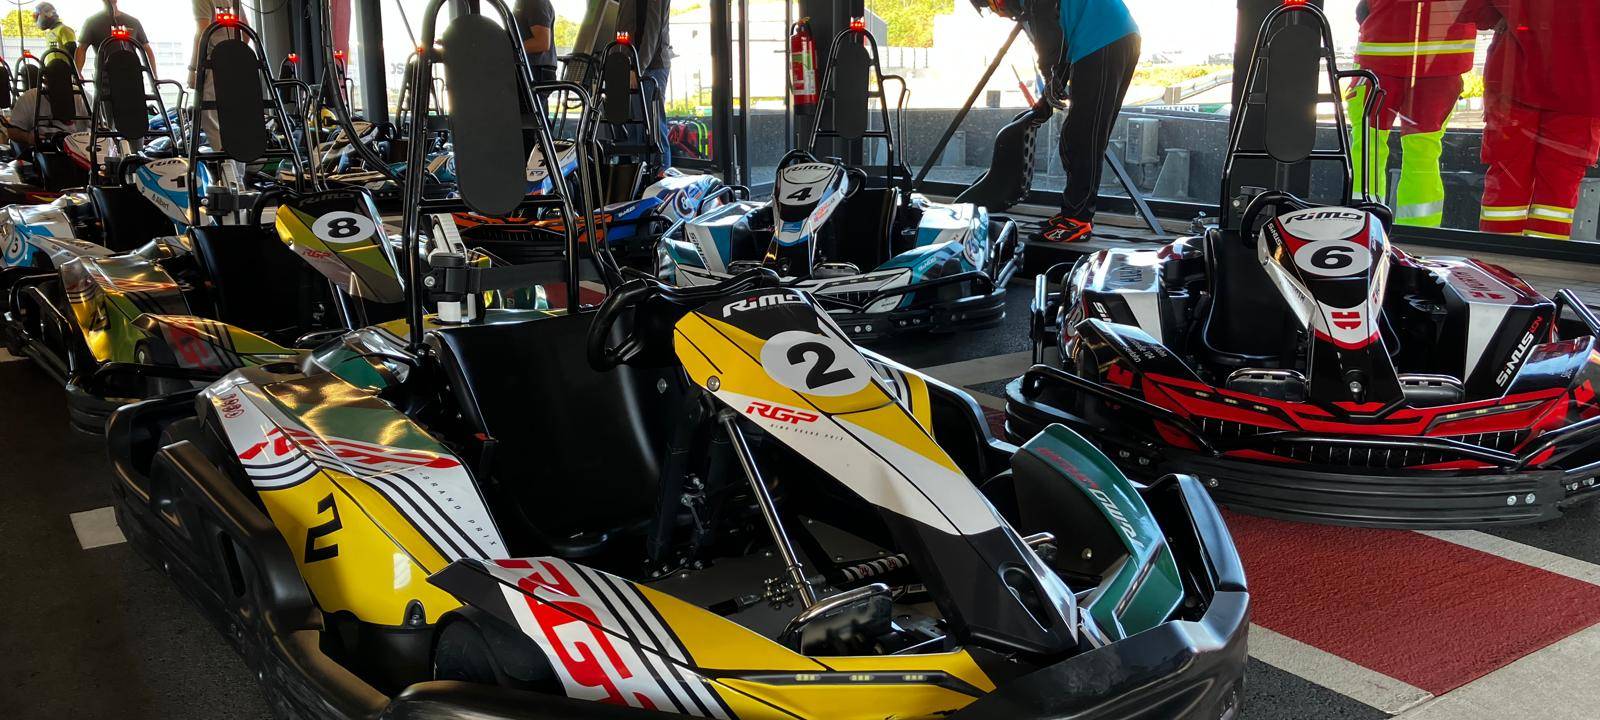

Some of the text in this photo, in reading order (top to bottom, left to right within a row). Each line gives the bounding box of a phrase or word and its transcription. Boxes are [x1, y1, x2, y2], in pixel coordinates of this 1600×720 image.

[170, 175, 186, 188] 1
[786, 187, 813, 201] 4
[327, 217, 361, 239] 8
[1310, 245, 1355, 270] 6
[786, 341, 856, 390] 2
[745, 401, 820, 425] RGP
[422, 474, 497, 545] GRAND PRIX
[304, 492, 343, 564] 2
